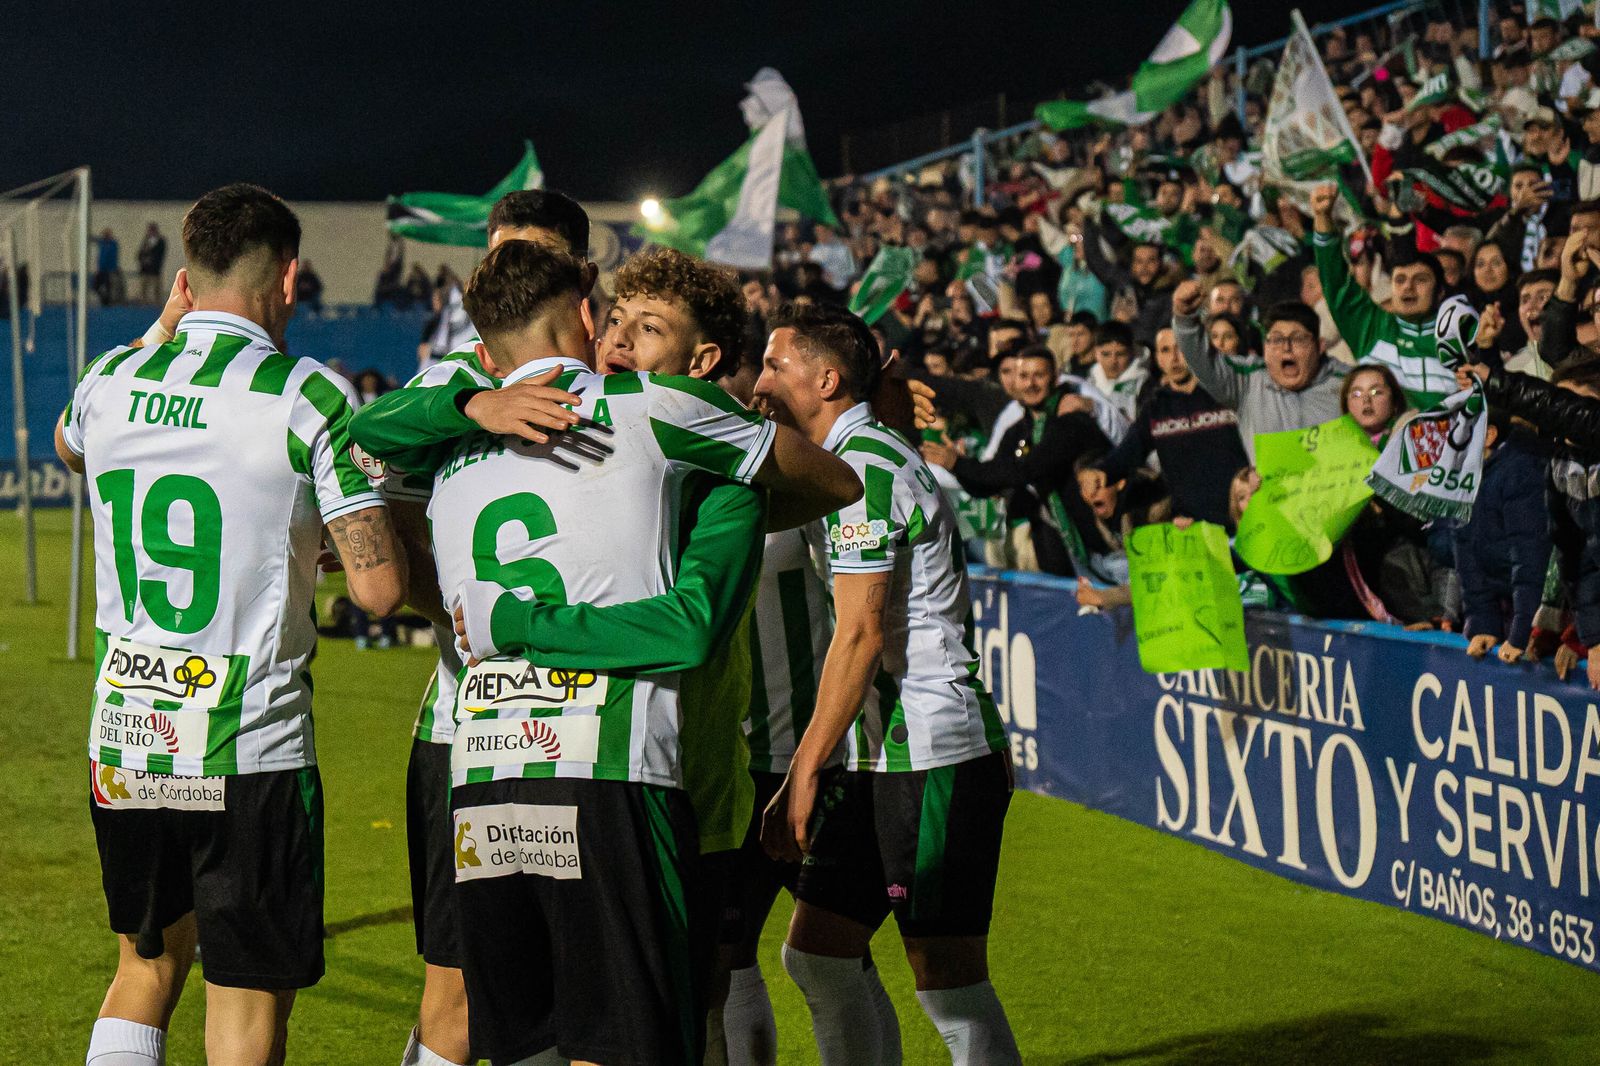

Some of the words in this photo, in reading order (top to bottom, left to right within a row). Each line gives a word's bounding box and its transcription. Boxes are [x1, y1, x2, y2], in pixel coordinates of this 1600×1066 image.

[128, 390, 208, 430] TORIL
[95, 468, 223, 634] 19
[101, 708, 156, 731] CASTRO
[99, 725, 122, 743] DEL
[125, 729, 155, 748] RÍO
[466, 734, 534, 753] PRIEGO
[137, 784, 157, 801] de
[160, 783, 223, 802] Córdoba
[1154, 694, 1378, 889] SIXTO
[486, 823, 575, 844] Diptación
[1384, 757, 1418, 844] Y
[1434, 769, 1600, 898] SERVI
[490, 848, 516, 866] de
[519, 847, 579, 868] órdoba
[1391, 860, 1415, 908] C/
[1419, 867, 1501, 938] BAÑOS,
[1505, 895, 1534, 943] 38
[1549, 909, 1596, 964] 653
